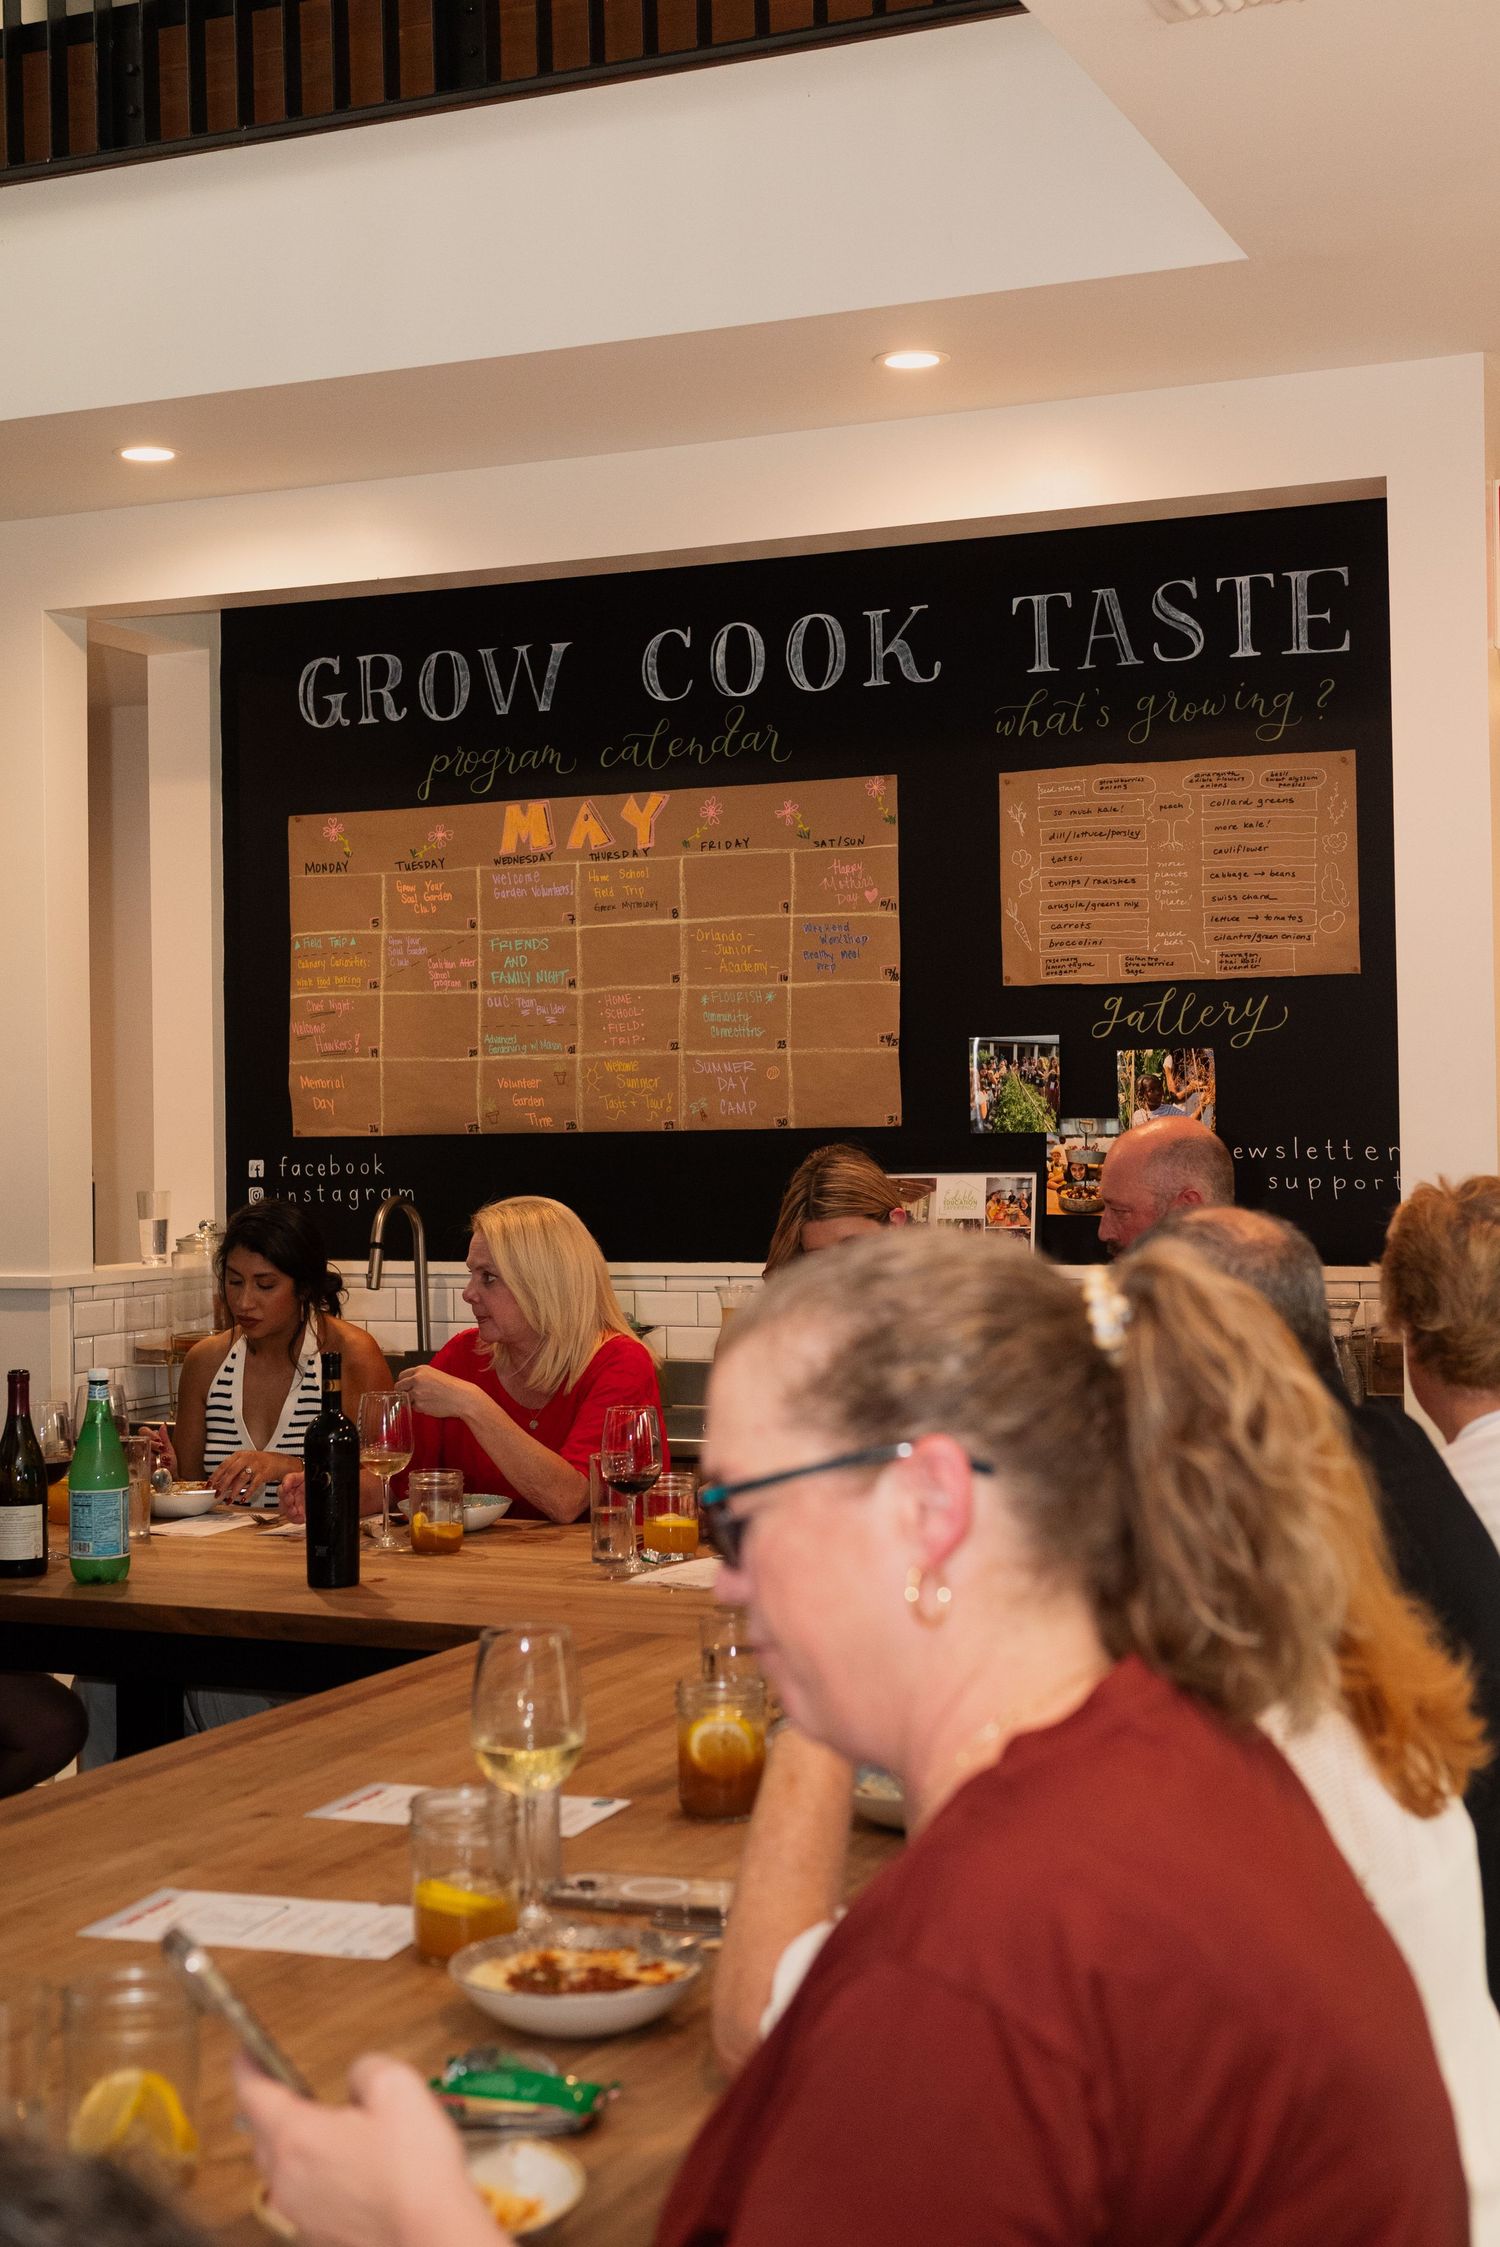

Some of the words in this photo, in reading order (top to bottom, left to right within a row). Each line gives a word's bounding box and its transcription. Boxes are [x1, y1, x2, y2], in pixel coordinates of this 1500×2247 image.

[299, 642, 573, 728] GROW
[641, 605, 941, 701] COOK
[1012, 566, 1350, 673] TASTE
[995, 688, 1109, 738] what's
[1128, 682, 1303, 744] growing
[417, 739, 575, 799] program
[600, 705, 791, 769] calendar
[1159, 803, 1183, 811] peach
[1210, 799, 1252, 807] collard
[1257, 797, 1295, 808] greens
[500, 792, 670, 854] MAY
[1243, 820, 1272, 828] kale!
[701, 837, 750, 851] FRIDAY
[813, 836, 865, 848] SAT/SUN
[589, 848, 650, 861] THURSDAY
[1213, 845, 1269, 855] cauliflower
[395, 858, 445, 871] TUESDAY
[494, 852, 553, 865] WEDNESDAY
[305, 860, 349, 875] MONDAY
[619, 867, 649, 879] School
[492, 871, 540, 885] Welcome
[1210, 871, 1249, 880] cabbage
[1270, 870, 1296, 878] beans
[396, 880, 416, 893] Grow
[425, 880, 444, 890] Your
[494, 885, 526, 899] Garden
[594, 888, 614, 897] Field
[623, 885, 645, 898] Trip
[423, 892, 452, 901] Garden
[835, 894, 858, 905] Day
[414, 903, 436, 913] Club
[671, 909, 678, 919] 8
[783, 903, 789, 913] 9
[372, 919, 379, 927] 5
[469, 919, 476, 928] 6
[568, 915, 575, 924] 7
[1051, 922, 1091, 930] carrots
[696, 929, 743, 941] Orlando
[489, 938, 550, 951] FRIENDS
[1049, 939, 1103, 948] broccolini
[714, 944, 752, 956] Junior
[504, 955, 528, 968] AND
[720, 960, 768, 975] Academy
[491, 970, 531, 986] FAMILY
[536, 969, 570, 984] NIGHT
[672, 975, 680, 983] 15
[605, 994, 632, 1005] HOME
[605, 1008, 641, 1019] SCHOOL
[1092, 987, 1288, 1048] gallery
[608, 1022, 639, 1033] FIELD
[610, 1036, 640, 1046] TRIP
[777, 1041, 787, 1049] 23
[693, 1060, 756, 1074] SUMMER
[300, 1075, 345, 1089] Memorial
[498, 1078, 542, 1089] Volunteer
[717, 1076, 749, 1094] DAY
[512, 1094, 545, 1106] Garden
[313, 1097, 335, 1116] Day
[720, 1099, 758, 1115] CAMP
[525, 1112, 554, 1128] Time
[566, 1122, 576, 1130] 28
[664, 1121, 674, 1130] 29
[1233, 1137, 1400, 1160] ewsletter
[279, 1153, 385, 1177] facebook
[1268, 1171, 1400, 1200] support
[276, 1184, 415, 1210] instagram
